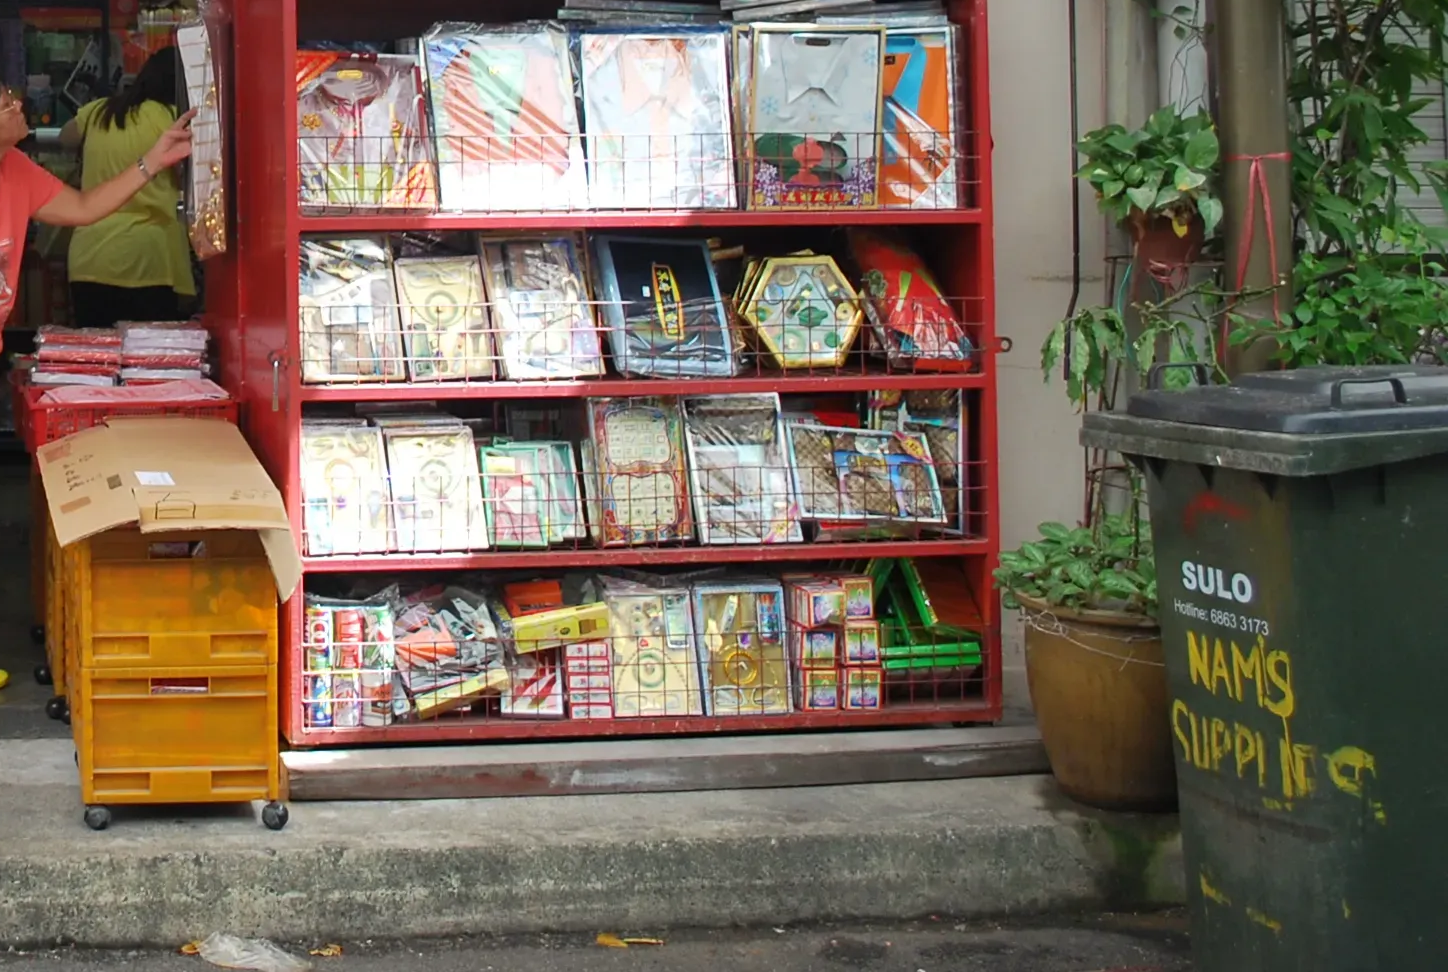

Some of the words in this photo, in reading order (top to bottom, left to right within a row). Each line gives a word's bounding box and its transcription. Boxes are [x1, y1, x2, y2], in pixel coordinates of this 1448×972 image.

[1181, 560, 1252, 603] SULO
[1174, 597, 1209, 621] Hotline:
[1210, 608, 1237, 629] 6863
[1239, 616, 1269, 636] 3173
